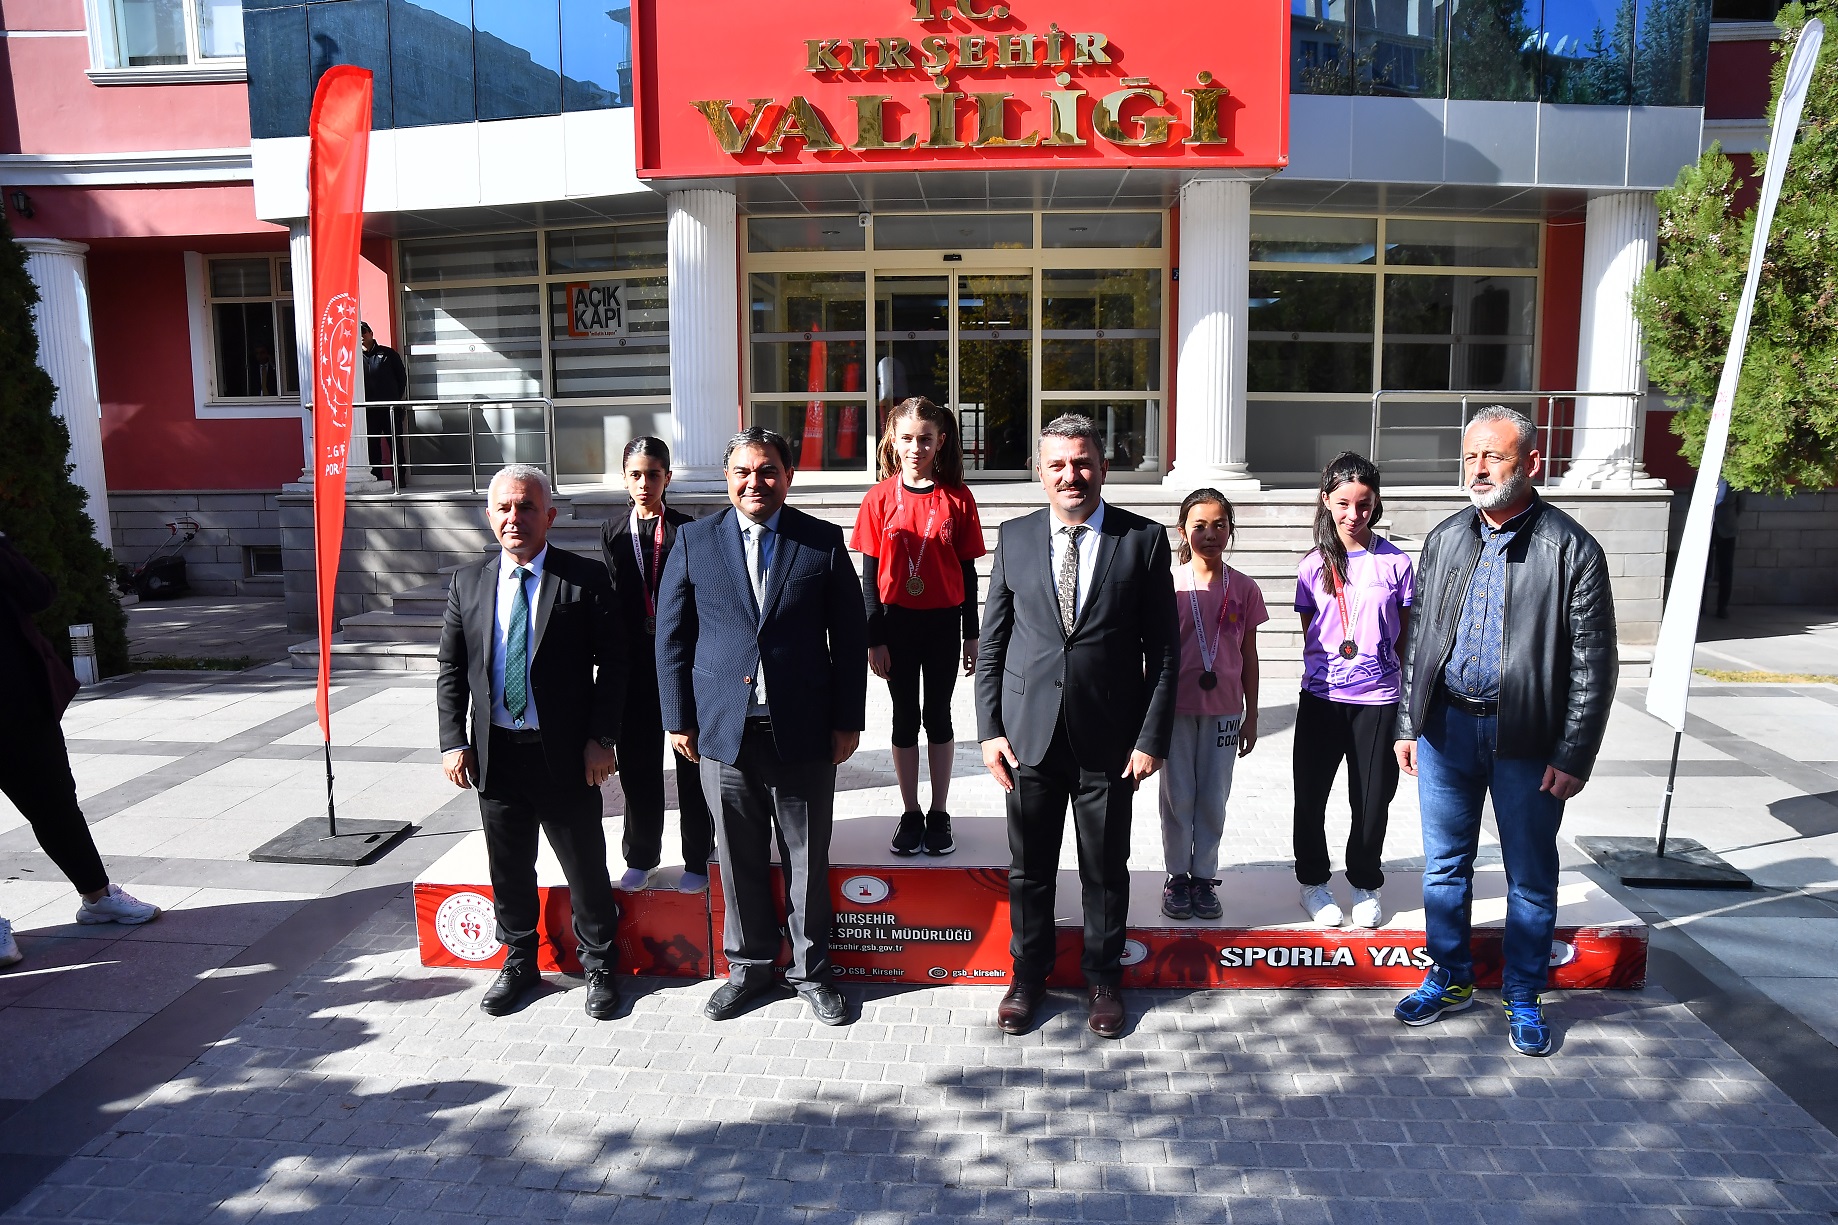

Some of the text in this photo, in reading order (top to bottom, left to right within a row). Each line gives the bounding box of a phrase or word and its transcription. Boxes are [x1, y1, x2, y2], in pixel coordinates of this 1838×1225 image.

[803, 23, 1112, 75] KIRŞEHİR
[689, 71, 1229, 154] VALİLİĞİ
[575, 286, 621, 309] AÇIK
[575, 307, 621, 330] KAPI
[858, 883, 872, 896] 1
[835, 912, 895, 926] KIRŞEHİR
[838, 927, 871, 940] SPOR
[875, 927, 887, 940] İL
[891, 926, 972, 942] MÜDÜRLÜĞÜ
[1219, 945, 1435, 971] SPORLA YAŞ
[848, 967, 905, 977] GSB_Kirsehir
[951, 969, 1006, 979] gsb_kirsehir
